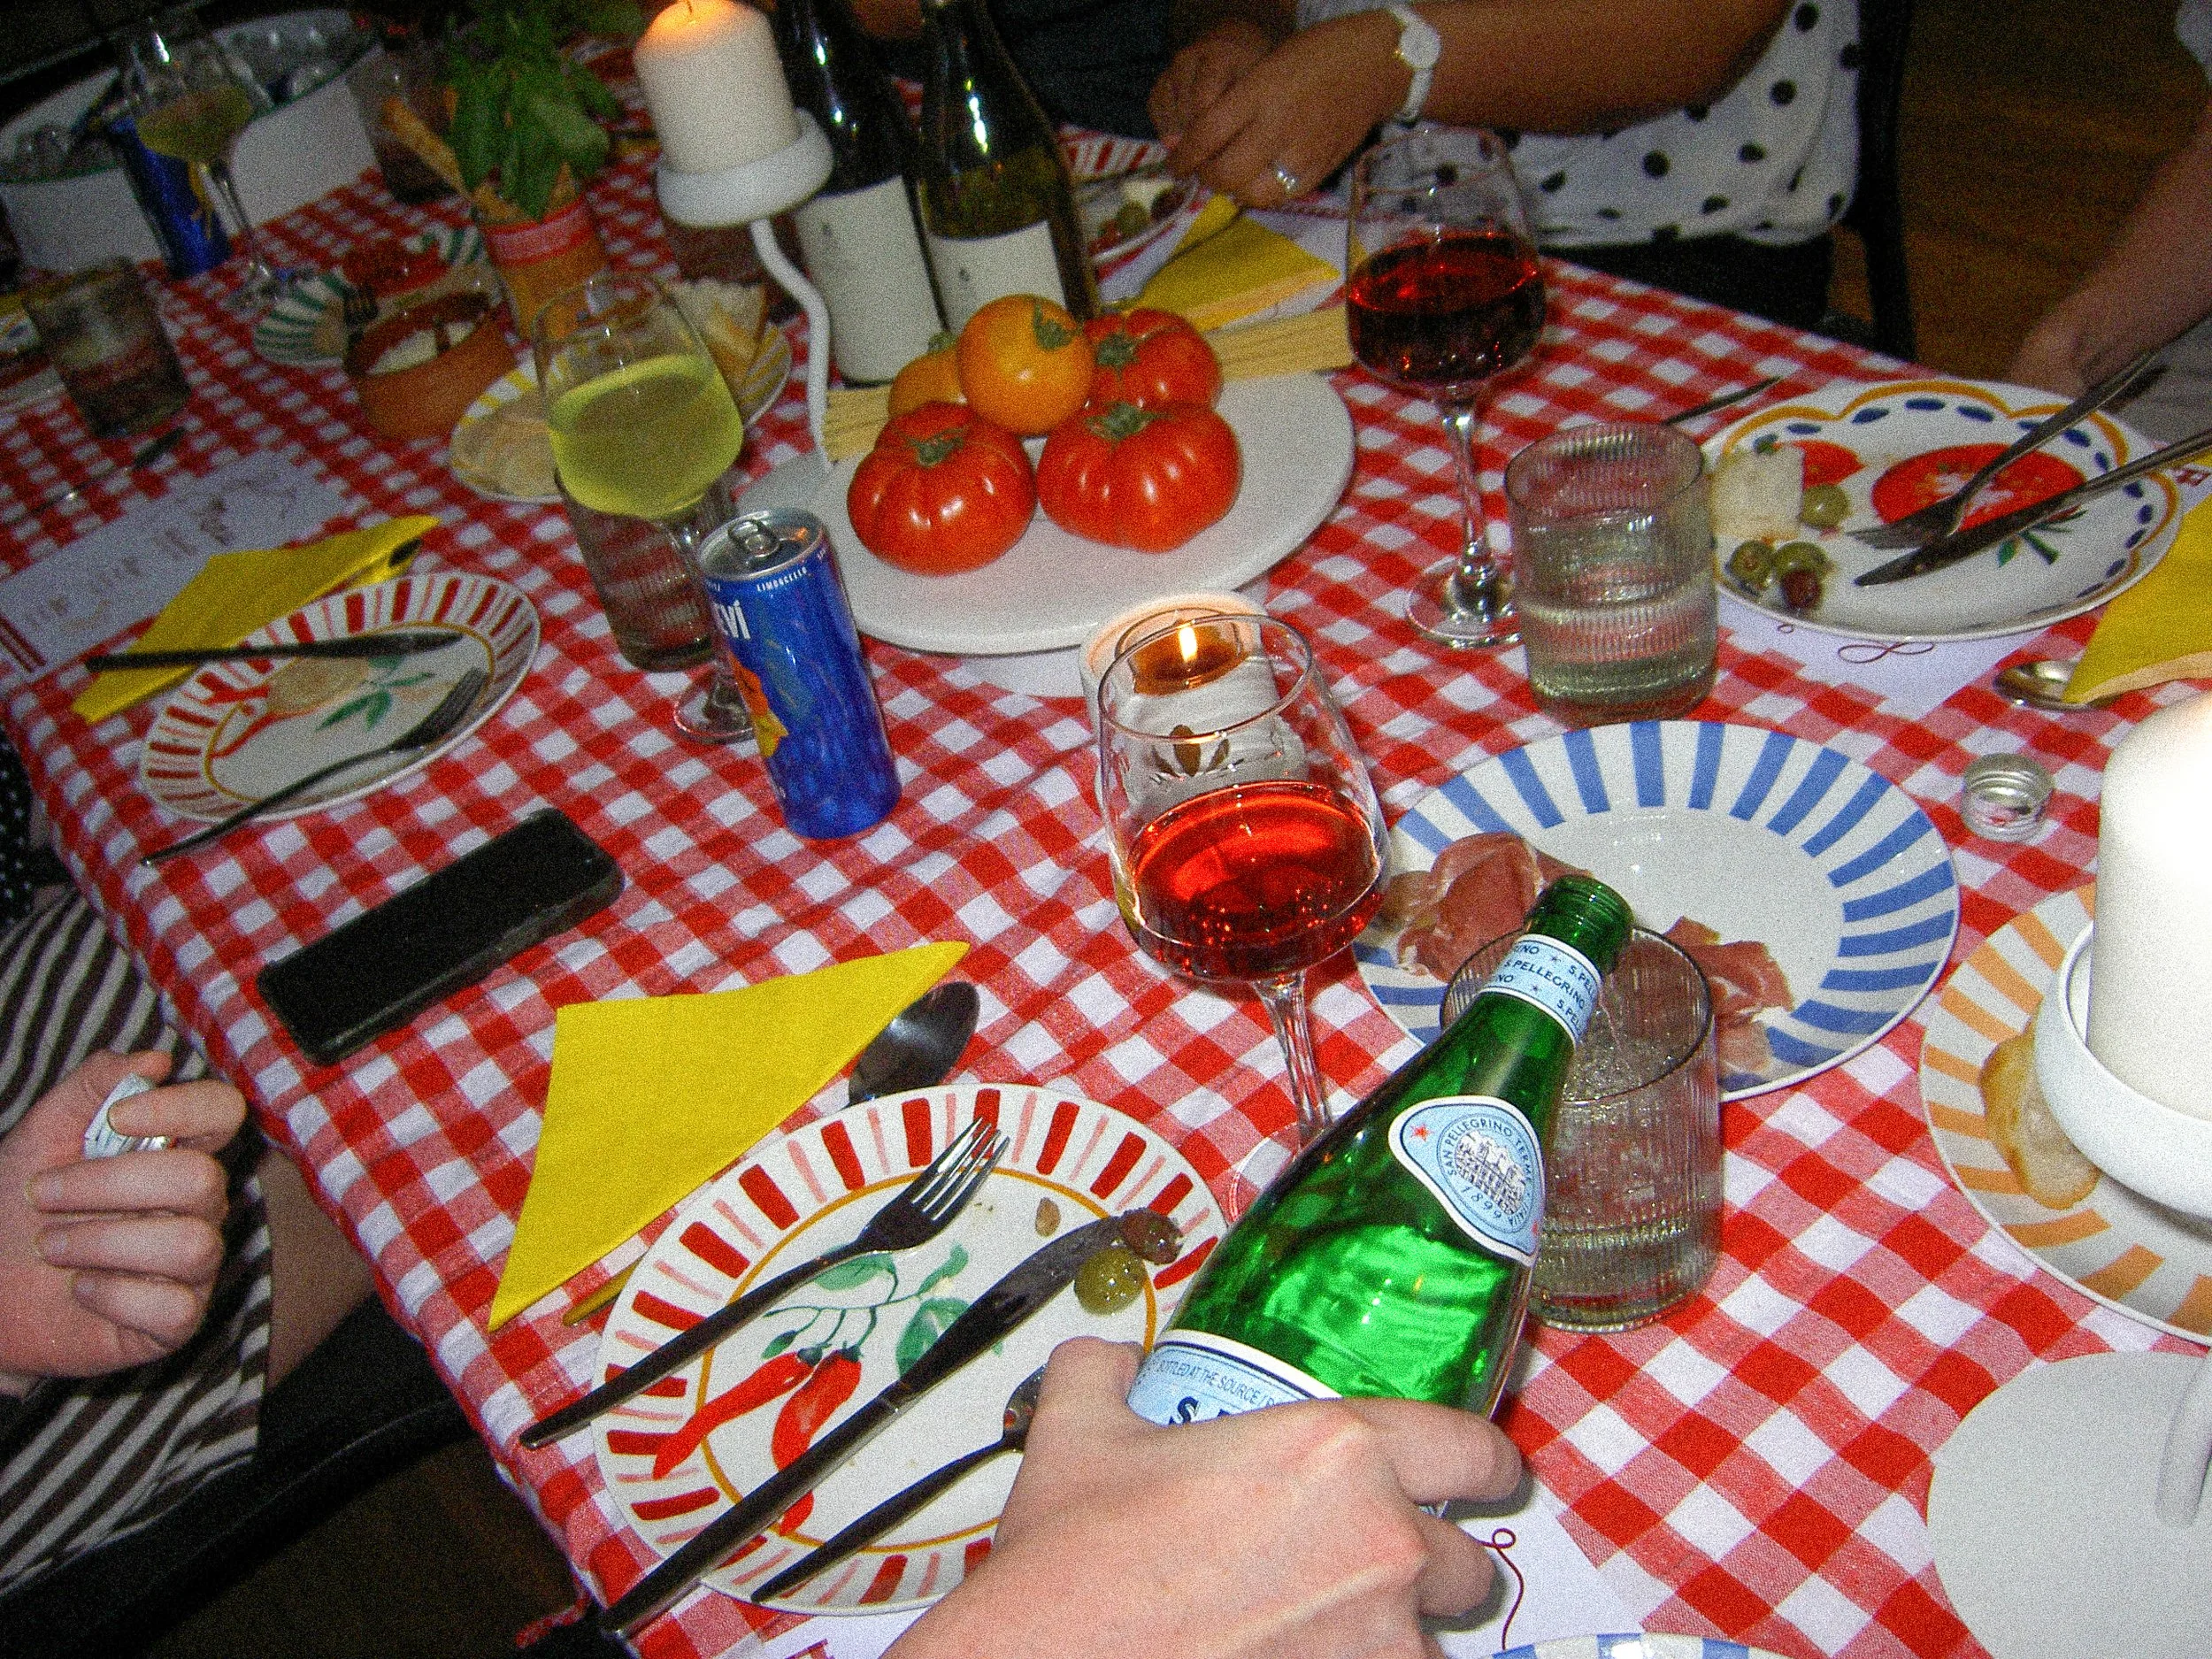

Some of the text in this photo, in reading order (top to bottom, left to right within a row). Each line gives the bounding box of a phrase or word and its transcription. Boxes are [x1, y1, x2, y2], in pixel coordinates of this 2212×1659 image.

[1445, 1118, 1513, 1146] PELLEGRINO
[1443, 1151, 1457, 1176] SAN
[1218, 1375, 1261, 1405] SOURCE
